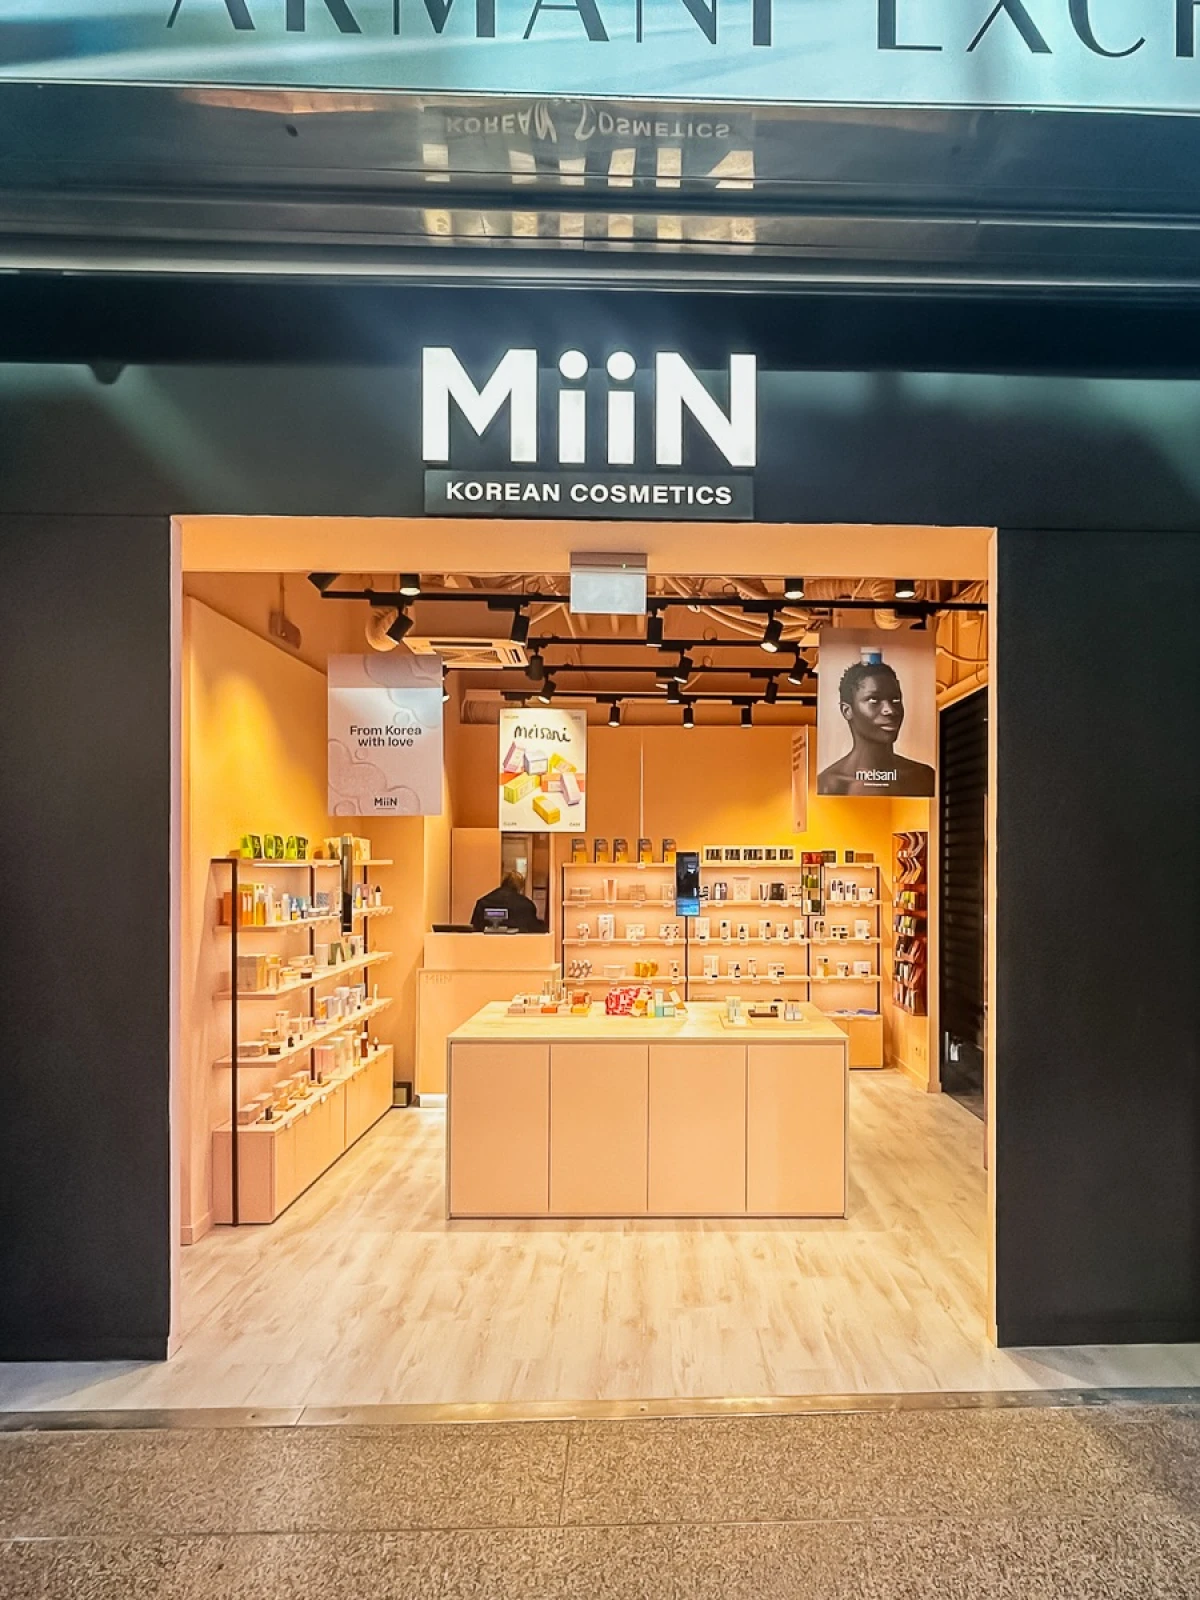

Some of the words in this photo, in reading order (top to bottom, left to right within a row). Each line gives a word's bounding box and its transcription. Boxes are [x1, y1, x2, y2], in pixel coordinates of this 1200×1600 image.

[422, 346, 757, 468] MiiN
[446, 481, 561, 502] KOREAN
[570, 483, 732, 505] COSMETICS
[350, 725, 382, 736] From
[385, 725, 422, 736] Korea
[358, 737, 385, 747] with
[388, 737, 414, 747] love
[374, 797, 398, 807] MiiN
